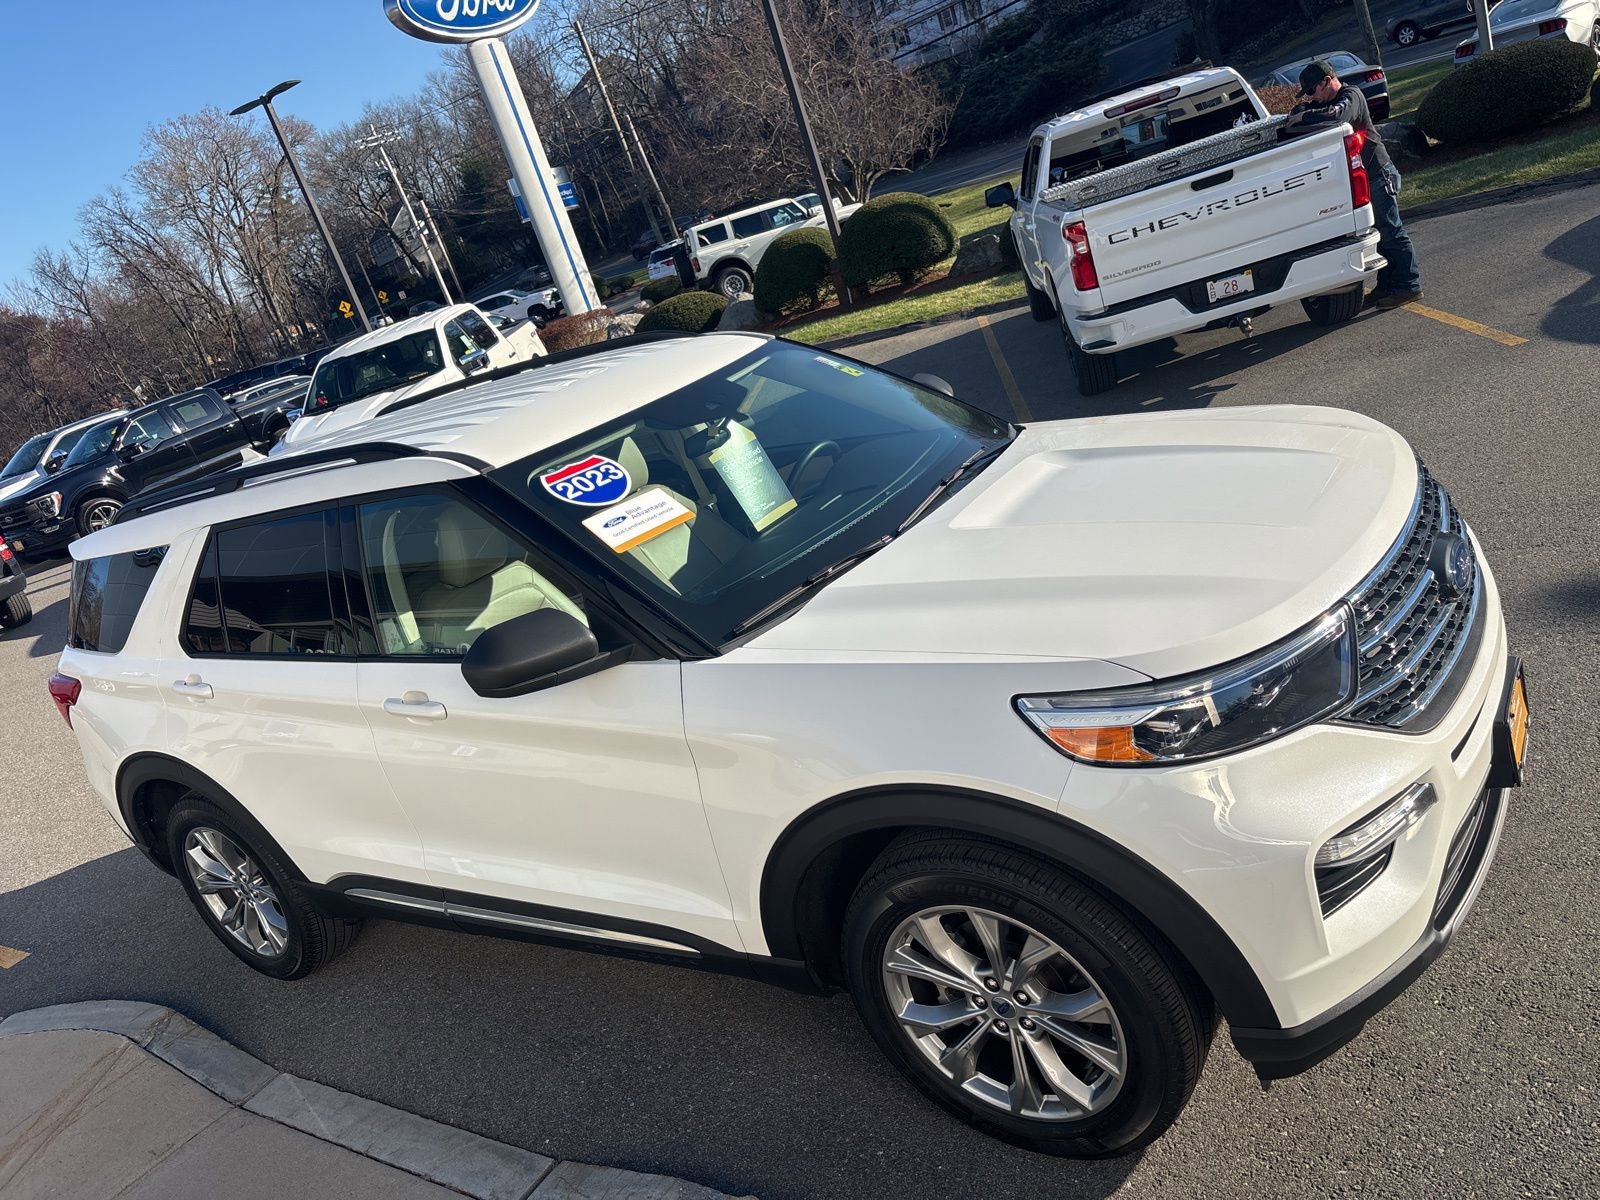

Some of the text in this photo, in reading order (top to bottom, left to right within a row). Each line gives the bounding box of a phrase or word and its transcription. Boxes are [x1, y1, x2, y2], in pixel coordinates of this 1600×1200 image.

[1108, 166, 1330, 246] CHEVROLET
[1316, 203, 1346, 216] RST
[1102, 260, 1162, 281] SILVERADO
[1223, 279, 1239, 294] 28
[556, 463, 624, 500] 2023
[625, 506, 642, 516] Blue
[631, 501, 667, 520] Advantage
